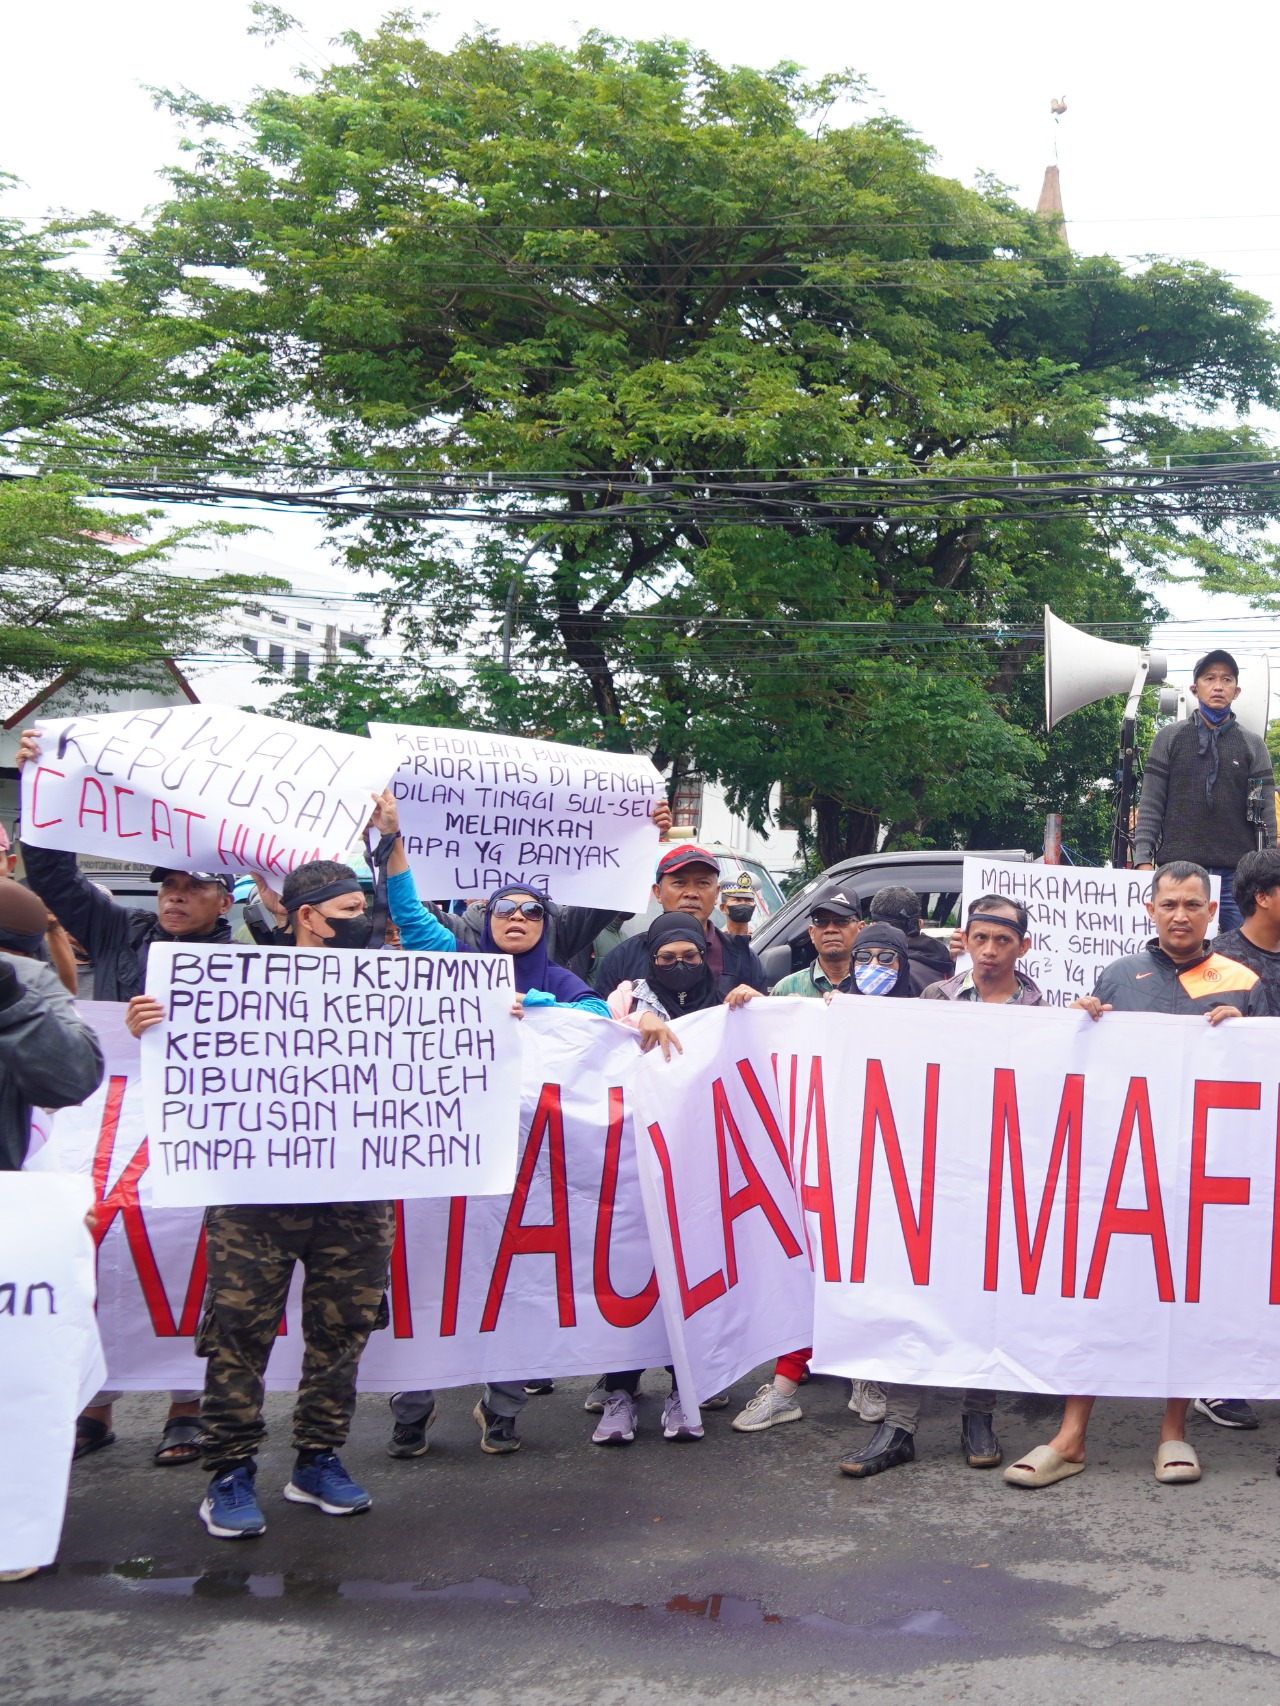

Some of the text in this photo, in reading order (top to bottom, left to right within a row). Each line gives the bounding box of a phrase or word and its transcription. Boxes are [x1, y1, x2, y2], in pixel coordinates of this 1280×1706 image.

[82, 708, 355, 786] AWAN
[396, 733, 521, 759] KEADILAN
[57, 723, 366, 851] KEPUTUSAN
[549, 766, 570, 787] DI
[32, 767, 206, 857] CACAT
[394, 781, 653, 818] DILAN TINGGI SUL-SEL
[446, 812, 593, 841] MELAINKAN
[475, 841, 501, 864] YG
[518, 842, 620, 870] BANYAK
[981, 868, 1116, 907] MAHKAMAH
[1076, 909, 1123, 934] KAMI
[170, 952, 511, 991] BETAPA KEJAMNYA
[168, 990, 481, 1028] PEDANG KEADILAN
[166, 1029, 495, 1061] KEBENARAN TELAH
[165, 1063, 487, 1097] DIBUNGKAM OLEH
[162, 1098, 462, 1132] PUTUSAN HAKIM
[158, 1134, 480, 1175] TANPA HATI NURANI
